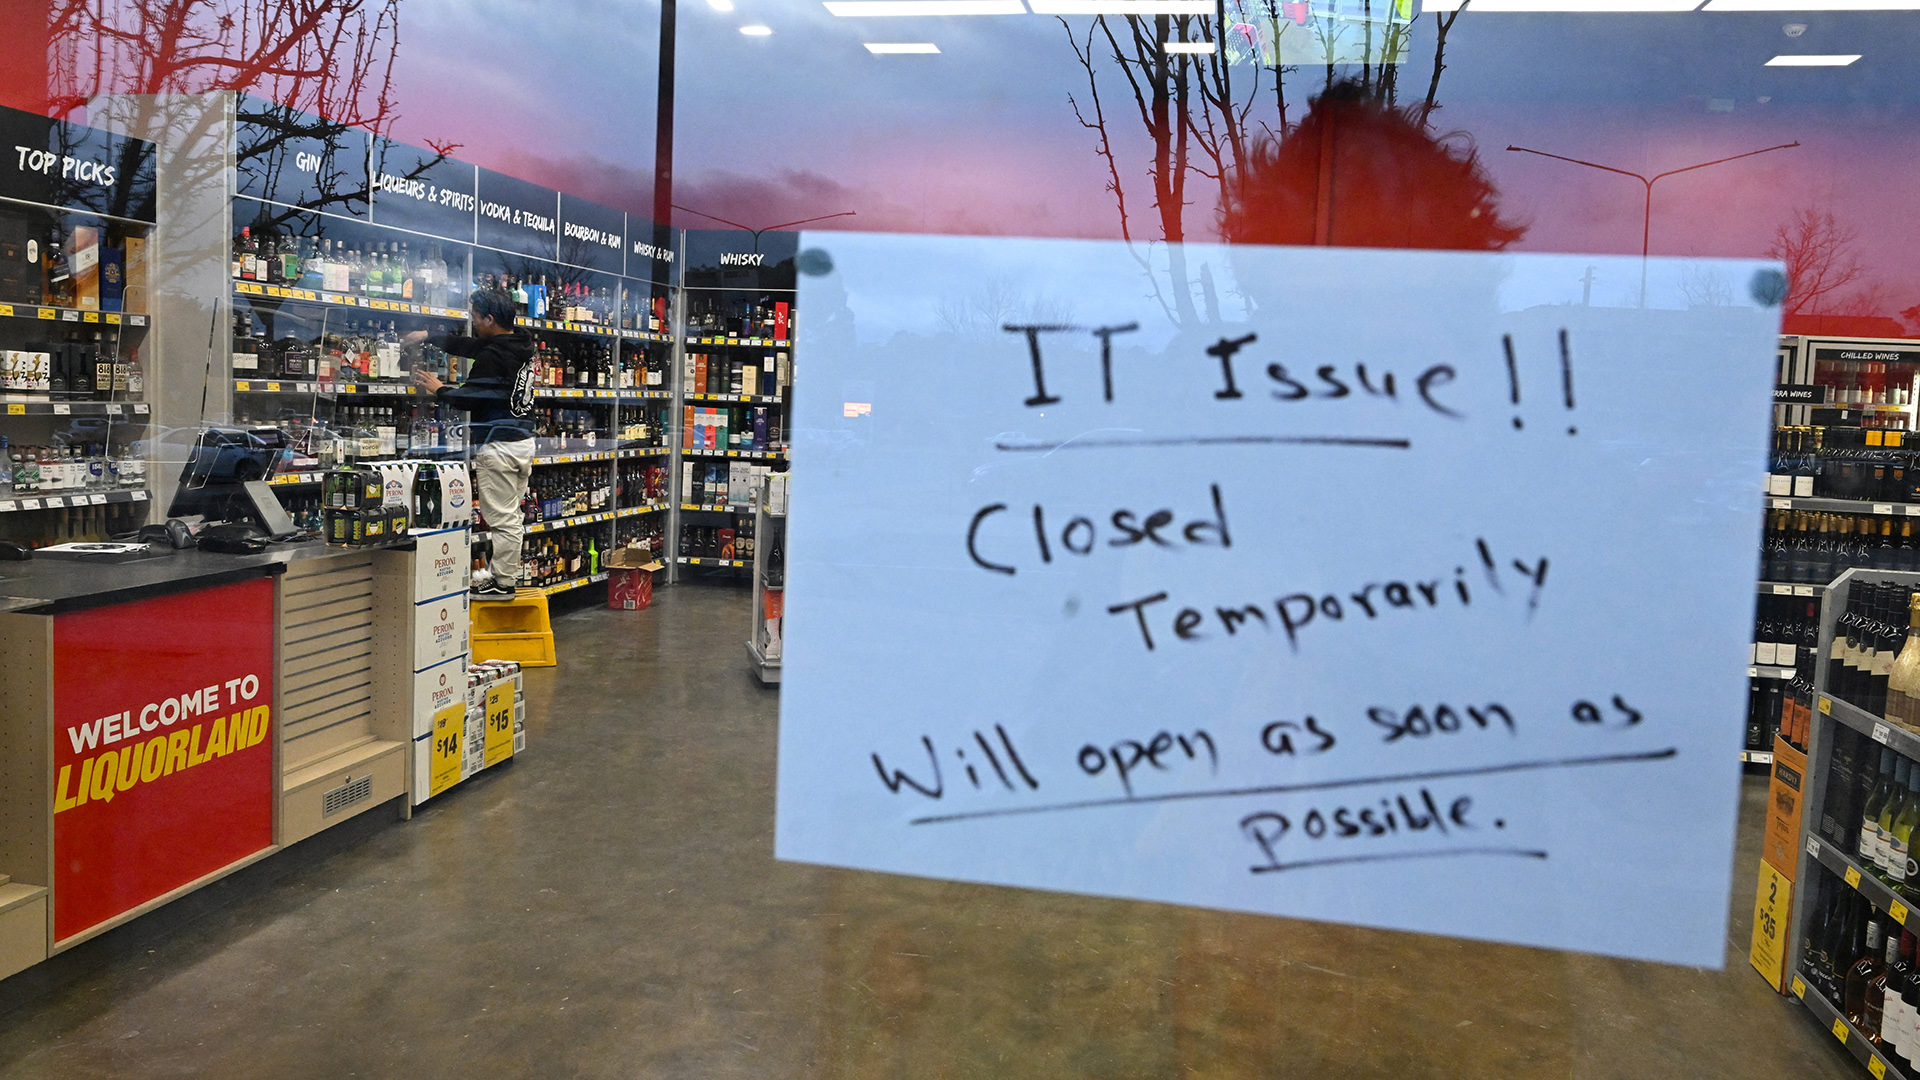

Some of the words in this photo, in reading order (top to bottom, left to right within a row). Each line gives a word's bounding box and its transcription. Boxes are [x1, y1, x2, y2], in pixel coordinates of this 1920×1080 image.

[15, 145, 56, 175] TOP
[61, 156, 116, 187] PICKS
[295, 151, 321, 174] GIN
[372, 170, 426, 200] LIQUEURS
[428, 186, 437, 202] &
[440, 188, 475, 212] SPIRITS
[480, 200, 510, 222] VODKA
[513, 209, 521, 225] &
[523, 211, 555, 235] TEQUILA
[564, 222, 600, 243] BOURBON
[600, 231, 608, 245] &
[608, 234, 621, 249] RUM
[633, 241, 656, 256] WHISKY
[657, 247, 665, 260] &
[664, 248, 675, 263] RUM
[720, 252, 764, 267] WHISKY
[1000, 320, 1141, 411] IT
[1840, 351, 1874, 360] CHILLED
[1875, 352, 1900, 360] WINES
[1790, 390, 1812, 398] WINES
[386, 489, 404, 497] PERONI
[965, 483, 1234, 577] Closed
[434, 556, 456, 569] PERONI
[1106, 536, 1549, 652] Temporarily
[433, 621, 455, 636] PERONI
[431, 685, 454, 702] PERONI
[67, 684, 219, 755] WELCOME
[225, 674, 260, 706] TO
[490, 708, 509, 733] $15
[54, 704, 270, 814] LIQUORLAND
[436, 732, 458, 759] $14
[870, 723, 1041, 801] Will
[1076, 723, 1222, 797] open
[1260, 713, 1338, 758] as
[1365, 702, 1517, 744] soon
[1570, 692, 1644, 728] as
[1239, 788, 1507, 866] possible.
[1769, 882, 1777, 905] 2
[1759, 908, 1776, 940] $35
